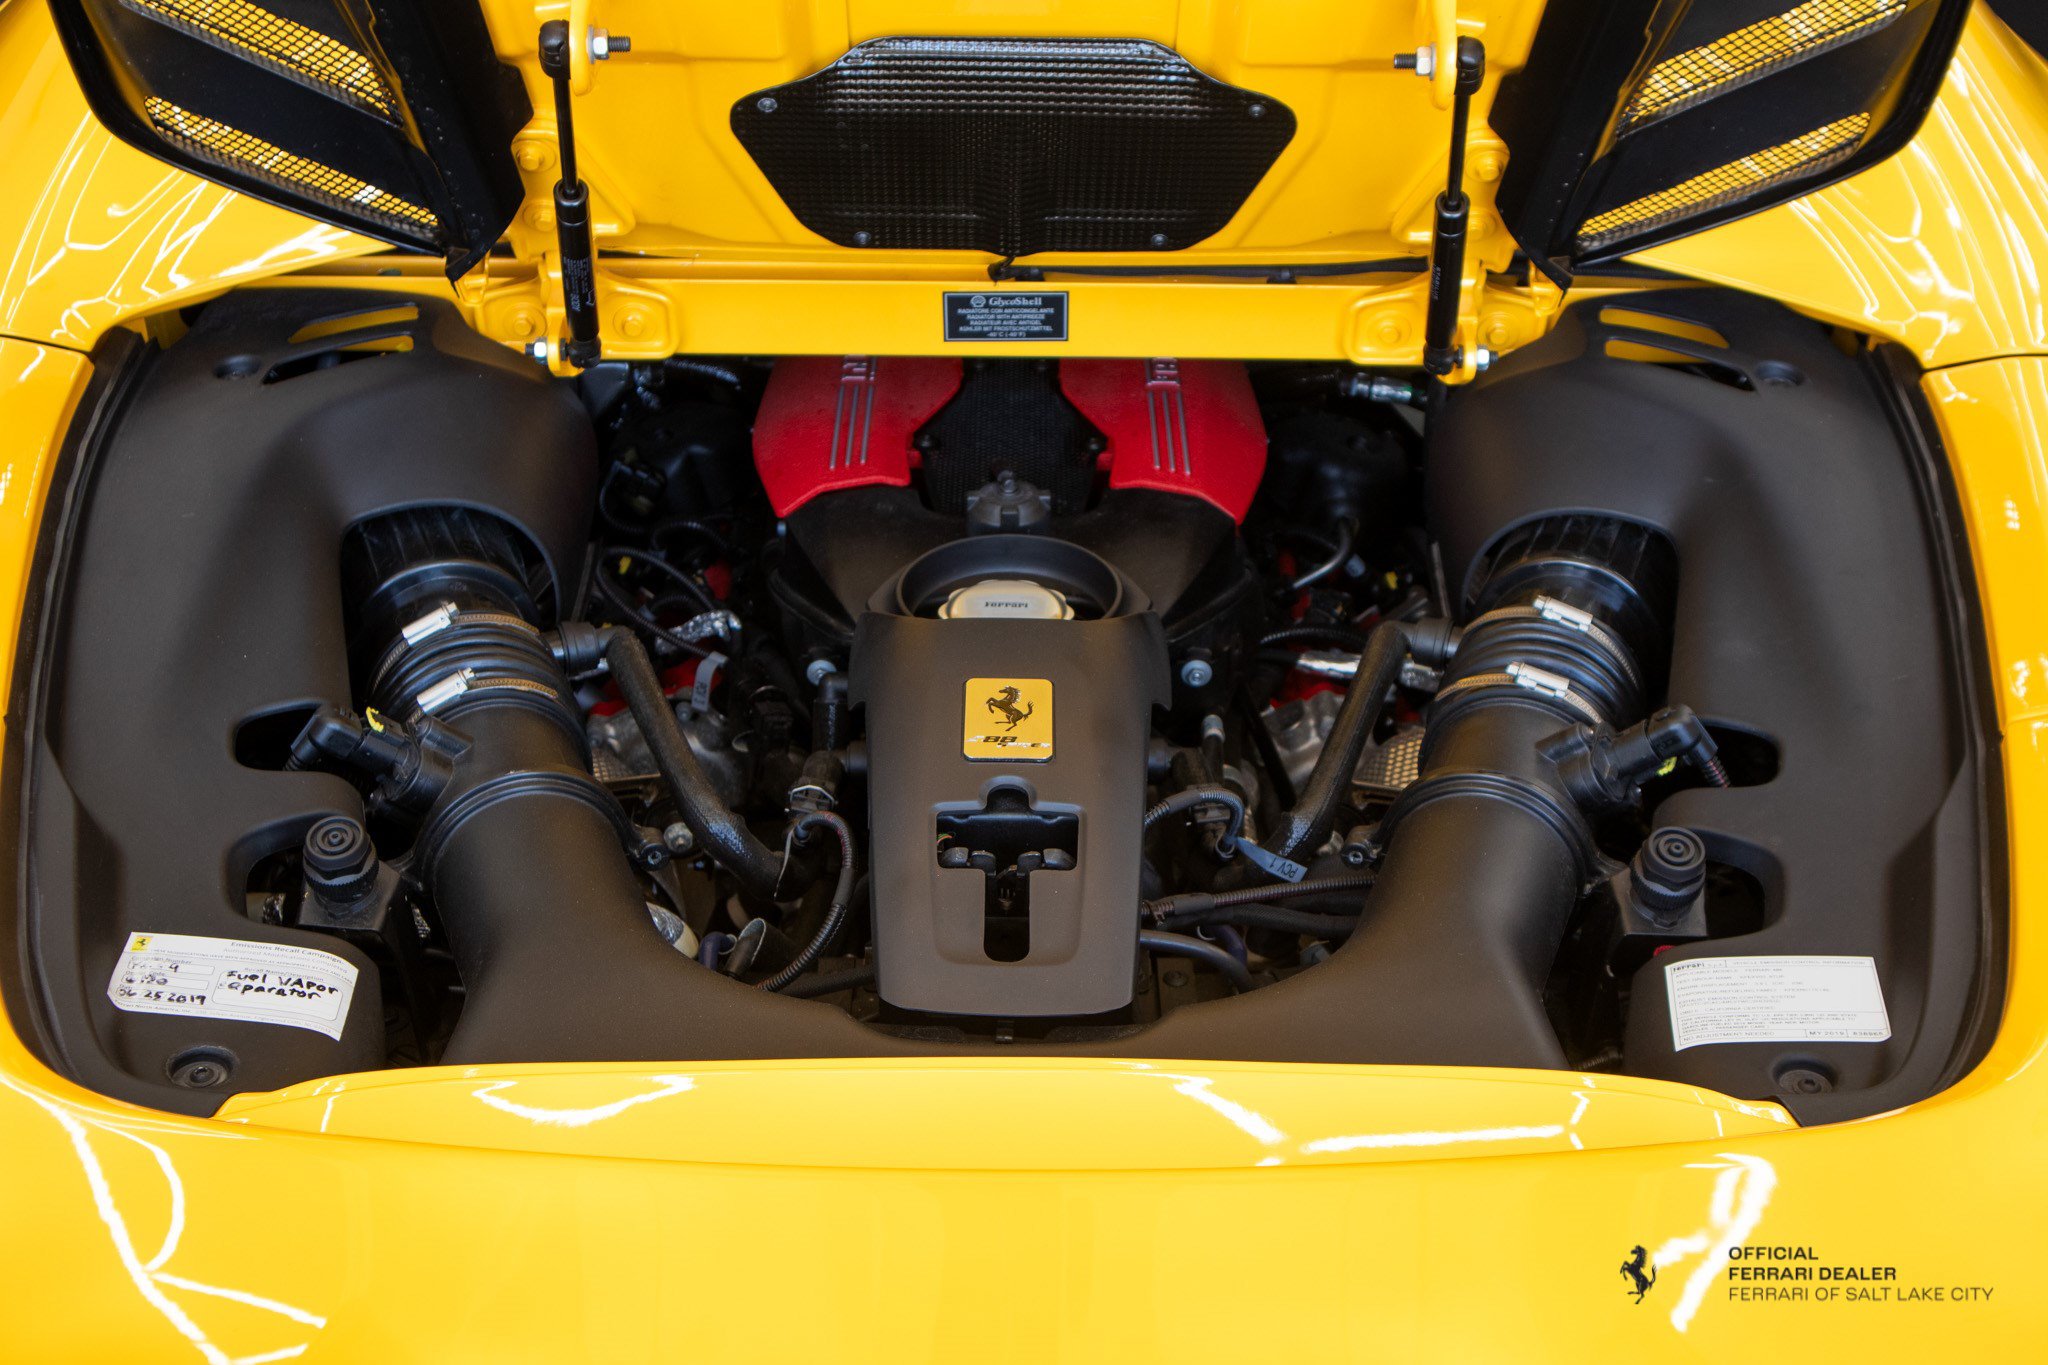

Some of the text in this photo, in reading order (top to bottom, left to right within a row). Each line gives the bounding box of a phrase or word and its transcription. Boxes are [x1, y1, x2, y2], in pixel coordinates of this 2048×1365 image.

[989, 297, 1042, 306] GlycoShell
[1277, 862, 1298, 878] PCV
[231, 942, 272, 950] Emissions
[1673, 962, 1705, 972] Ferrari
[227, 970, 267, 984] Fuel
[144, 990, 164, 1001] 25
[167, 992, 207, 1006] 2019
